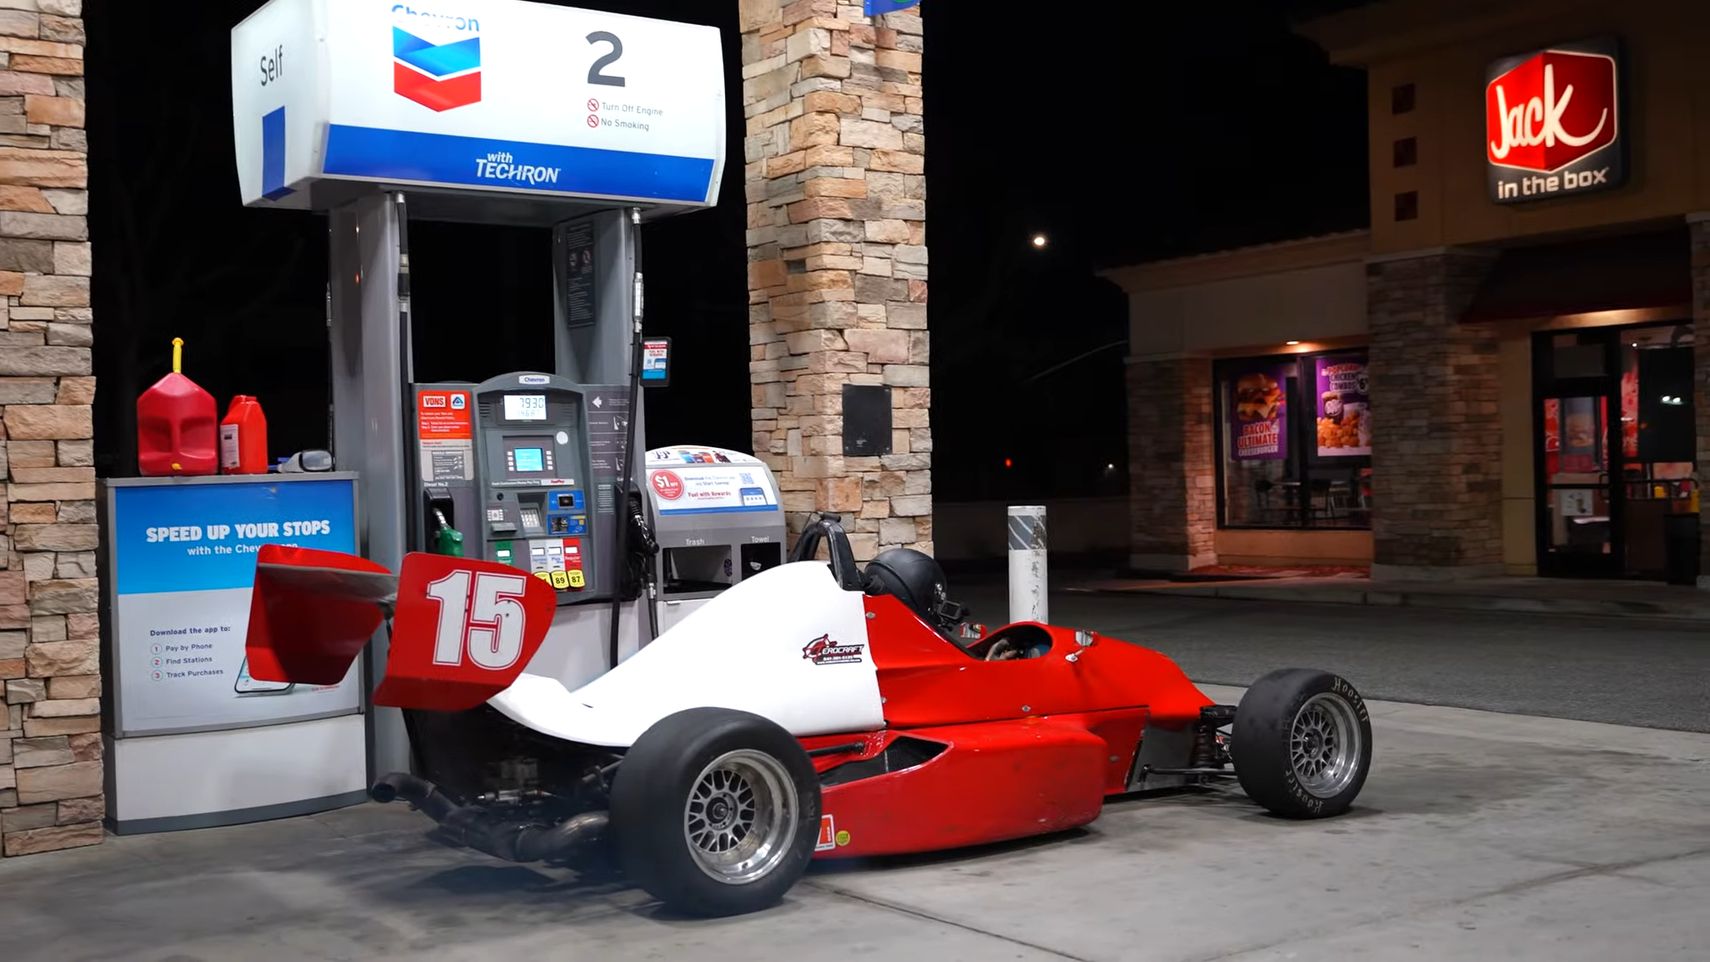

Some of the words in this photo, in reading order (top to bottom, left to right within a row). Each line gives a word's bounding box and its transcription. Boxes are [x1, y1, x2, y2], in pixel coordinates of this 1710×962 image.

[260, 44, 283, 87] Self
[585, 30, 626, 88] 2
[602, 101, 620, 111] Turn
[621, 104, 634, 113] Off
[636, 106, 664, 116] Engine
[1490, 63, 1608, 160] Jack
[600, 117, 613, 127] No
[614, 119, 650, 132] Smoking
[487, 151, 513, 164] with
[475, 158, 559, 185] TECHRON
[1498, 181, 1518, 199] in
[1522, 175, 1560, 196] the
[1563, 166, 1609, 189] box
[1237, 432, 1278, 448] ULTIMATE
[145, 526, 202, 543] SPEED
[207, 524, 230, 541] UP
[234, 522, 280, 540] YOUR
[282, 520, 331, 537] STOPS
[685, 538, 705, 546] Trash
[751, 535, 770, 544] Towel
[187, 546, 212, 556] with
[214, 544, 233, 555] the
[235, 544, 261, 554] Chev
[426, 569, 527, 671] 15
[150, 628, 187, 637] Download
[204, 626, 218, 634] app
[182, 656, 213, 664] Stations
[187, 669, 224, 677] Purchases
